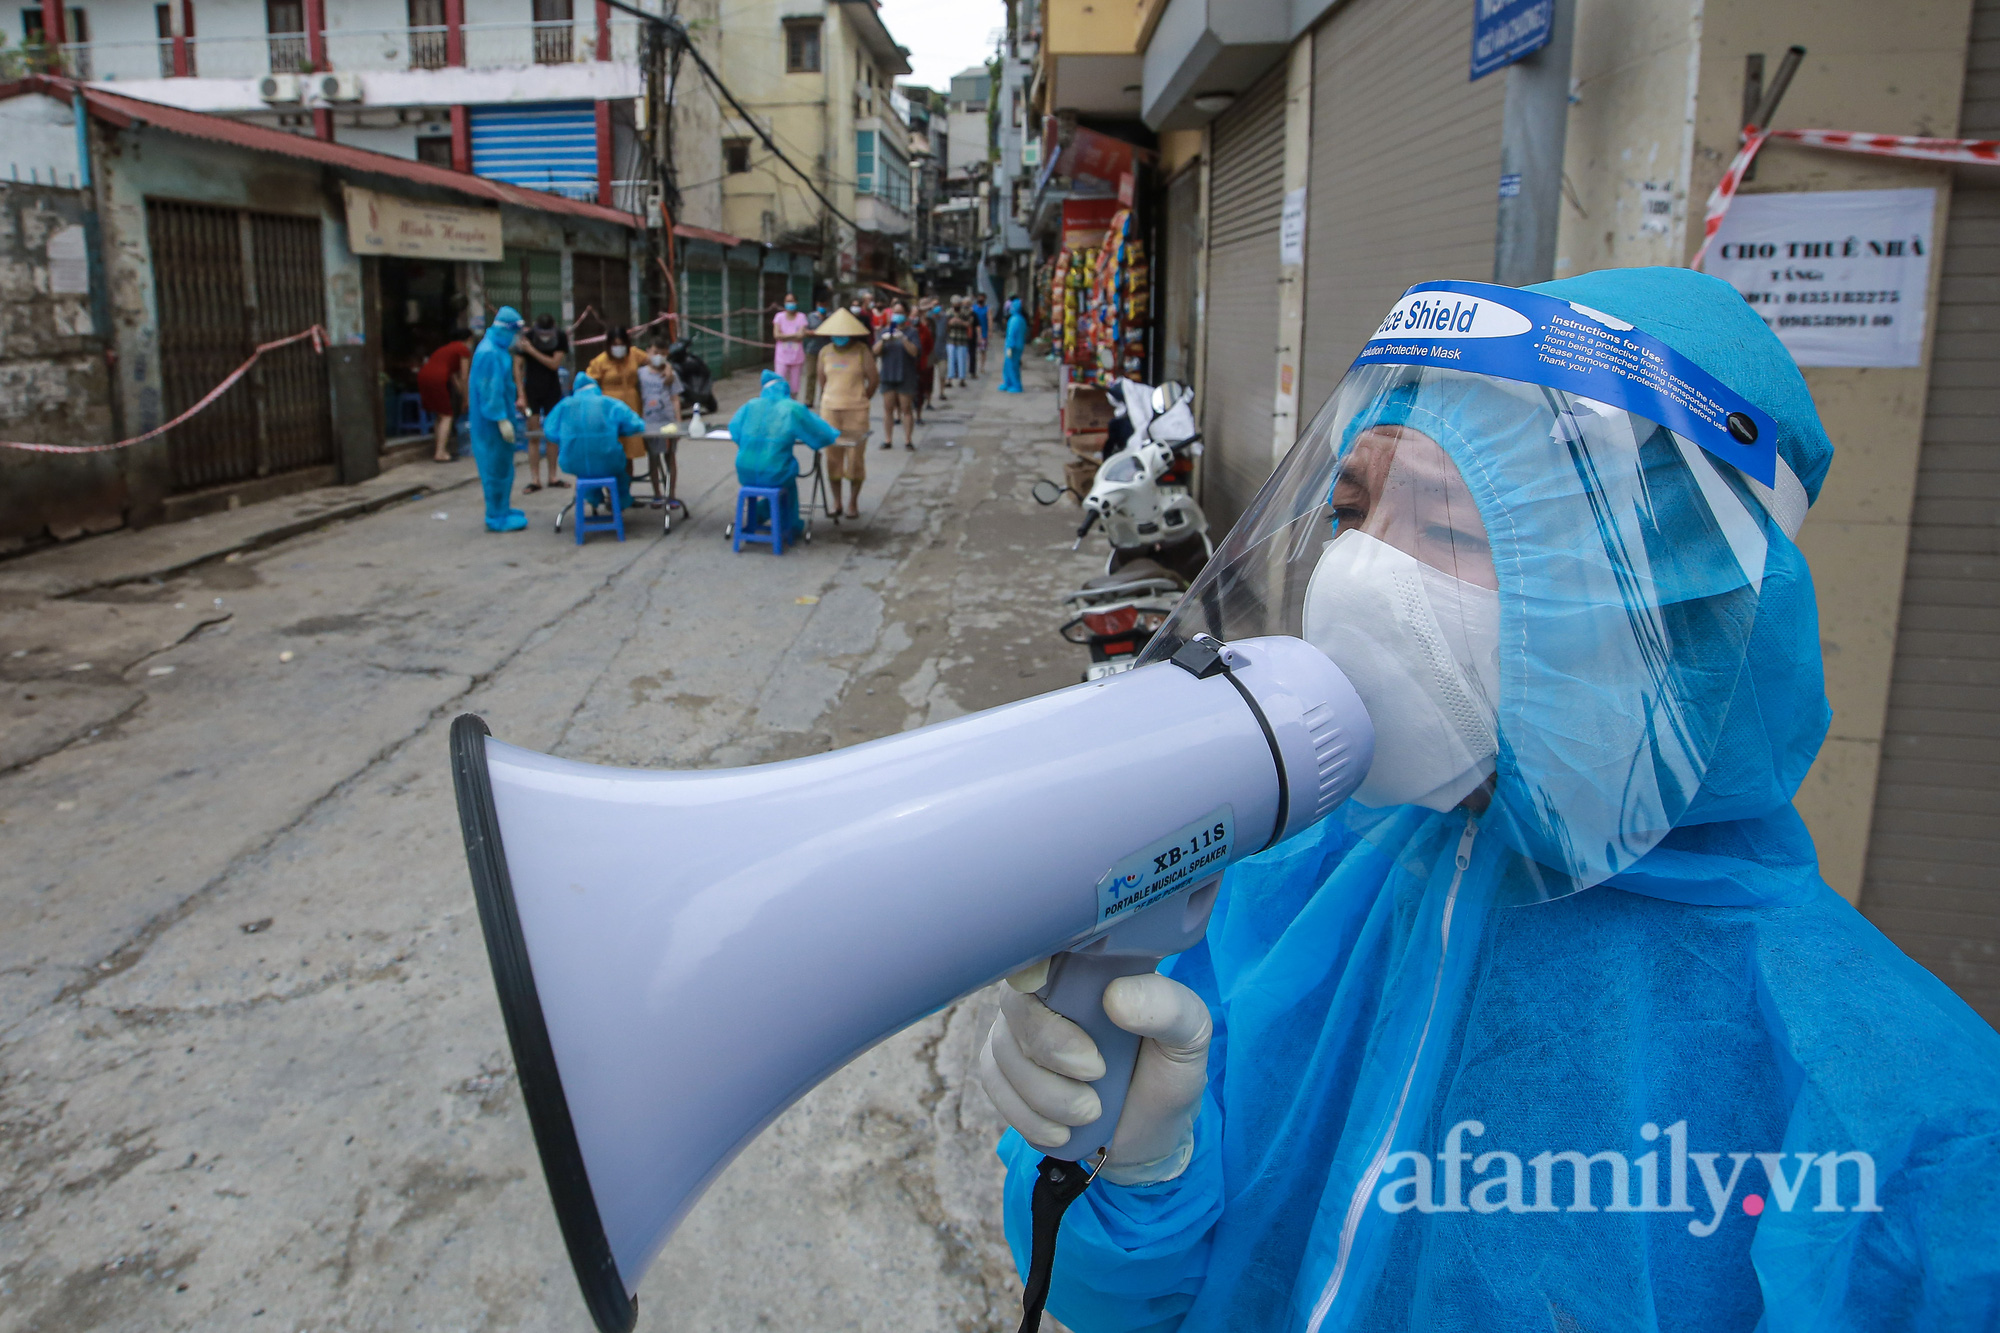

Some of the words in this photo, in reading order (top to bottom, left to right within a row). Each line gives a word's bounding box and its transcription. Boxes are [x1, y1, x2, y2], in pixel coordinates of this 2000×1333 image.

[1720, 241, 1776, 259] CHO
[1785, 236, 1859, 259] THUÊ
[1866, 234, 1924, 257] NHÀ
[1379, 310, 1403, 333] ace
[1404, 300, 1478, 333] Shield
[1551, 315, 1621, 344] Instructions
[1623, 339, 1639, 351] for
[1641, 347, 1664, 365] Use:
[1361, 345, 1384, 358] solution
[1384, 344, 1428, 357] Protective
[1430, 345, 1462, 360] Mask
[1538, 353, 1567, 367] Thank
[1568, 362, 1586, 373] you
[1544, 334, 1566, 346] from
[1567, 341, 1593, 356] being
[1595, 350, 1639, 371] scratched
[1640, 367, 1666, 386] during
[1667, 381, 1717, 418] transportation
[1549, 325, 1575, 339] There
[1577, 333, 1585, 342] is
[1595, 341, 1638, 362] protective
[1640, 357, 1659, 372] from
[1660, 368, 1668, 377] to
[1669, 375, 1695, 394] protect
[1696, 391, 1708, 402] the
[1709, 399, 1724, 414] face
[1540, 344, 1573, 358] Please
[1574, 353, 1609, 370] remove
[1611, 365, 1626, 376] the
[1627, 372, 1669, 396] protective
[1670, 391, 1688, 407] from
[1688, 404, 1712, 423] before
[1713, 420, 1727, 433] use
[1153, 822, 1225, 875] XB-11S
[1105, 885, 1151, 918] PORTABLE
[1151, 867, 1188, 894] MUSICAL
[1188, 844, 1227, 873] SPEAKER
